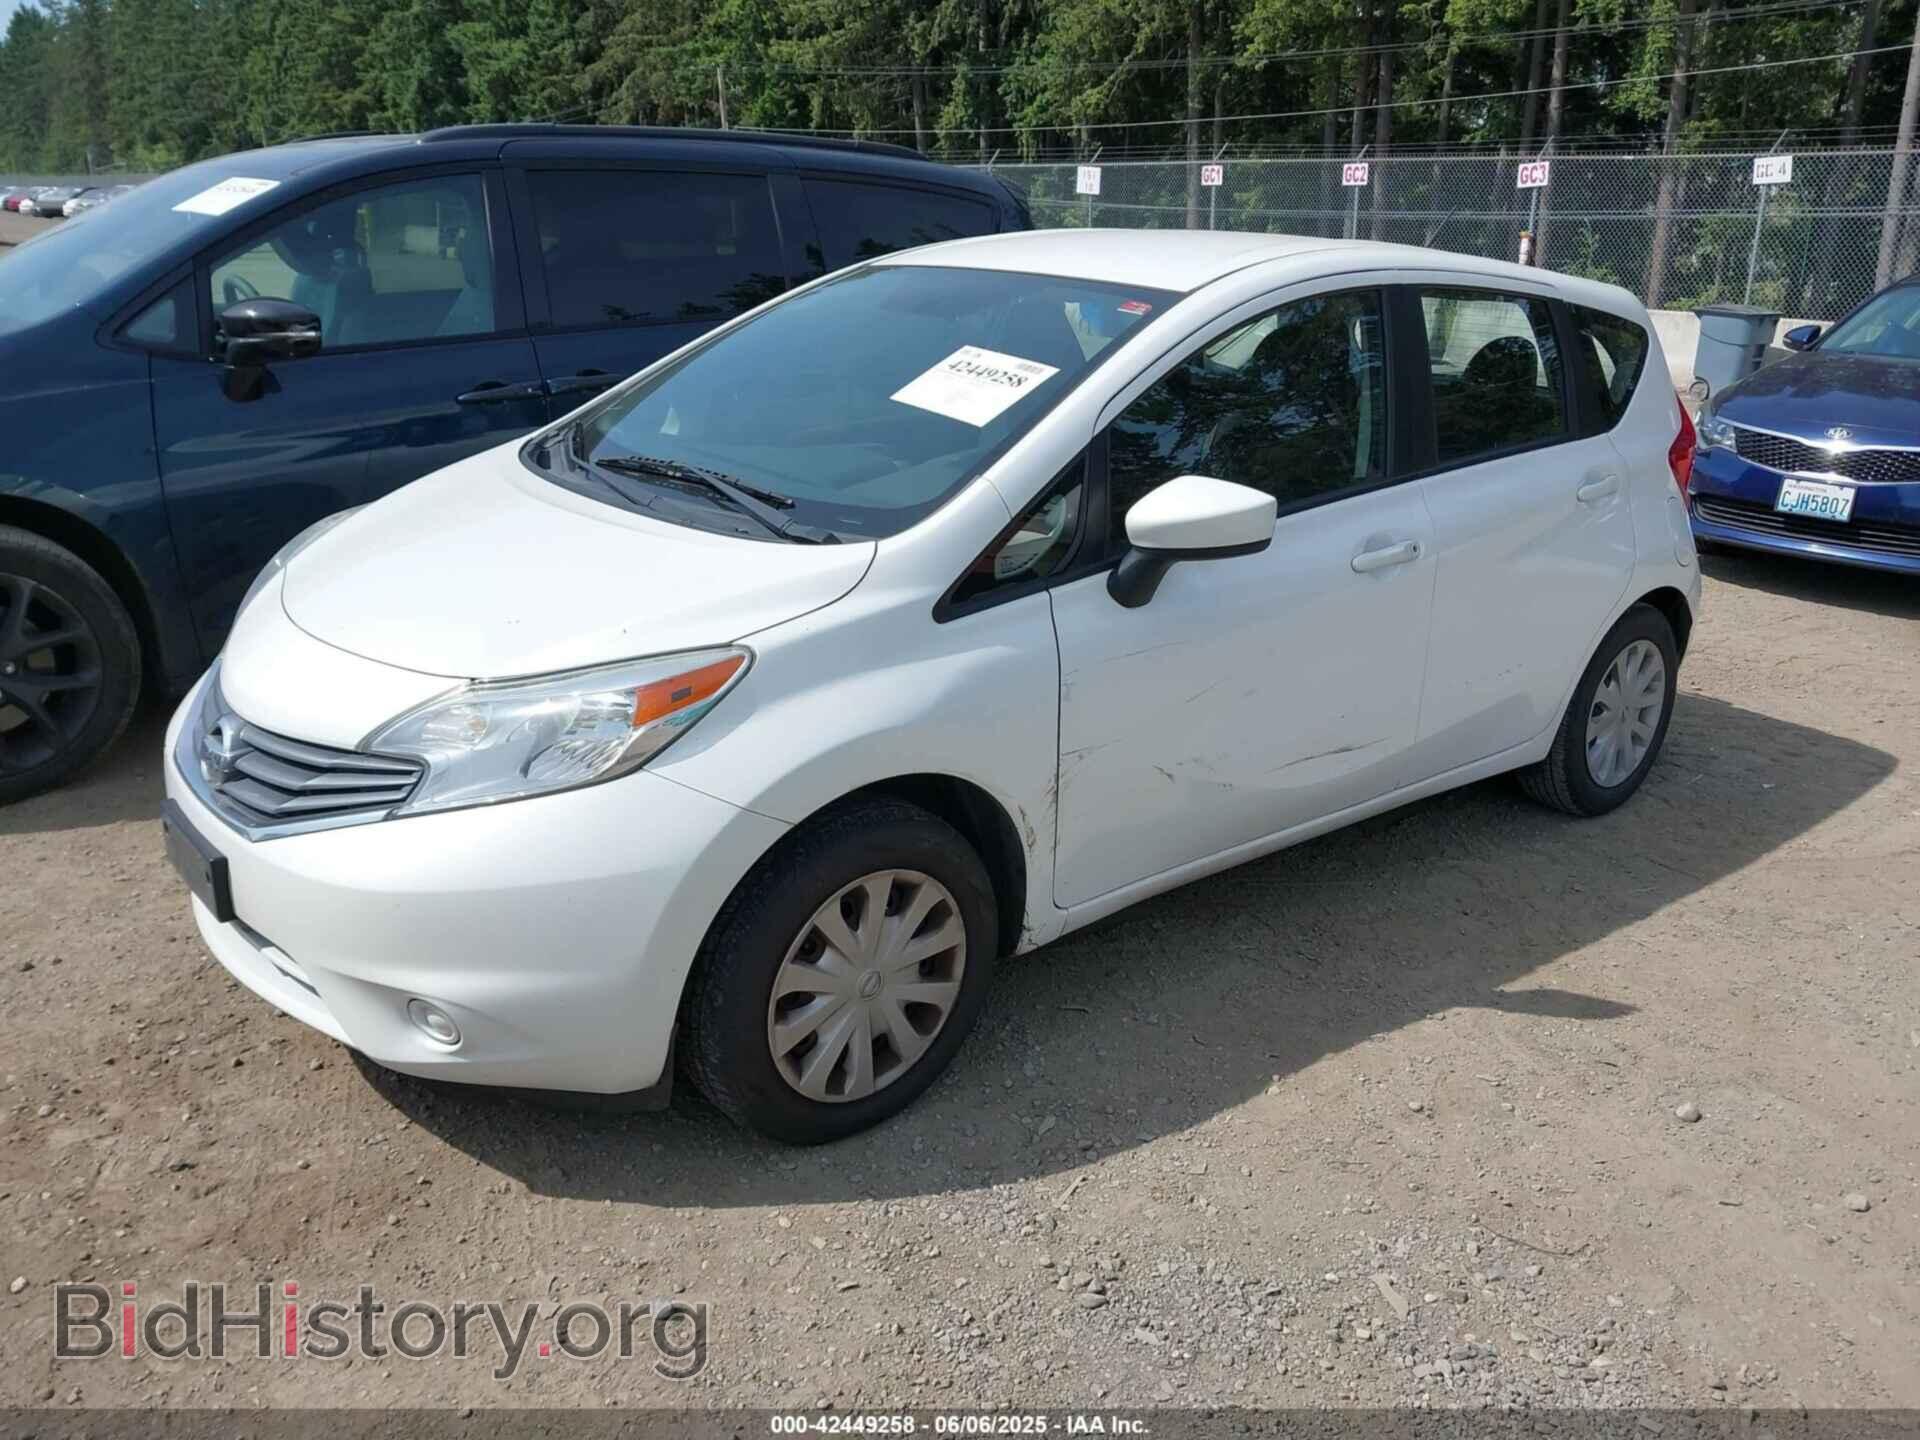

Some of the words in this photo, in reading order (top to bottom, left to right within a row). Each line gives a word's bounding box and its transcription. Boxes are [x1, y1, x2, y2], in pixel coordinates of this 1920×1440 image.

[1203, 167, 1220, 183] GC1
[1344, 166, 1366, 183] GC2
[1520, 164, 1545, 184] GC3
[948, 360, 1029, 388] 42449258
[1780, 490, 1850, 517] CJH5807
